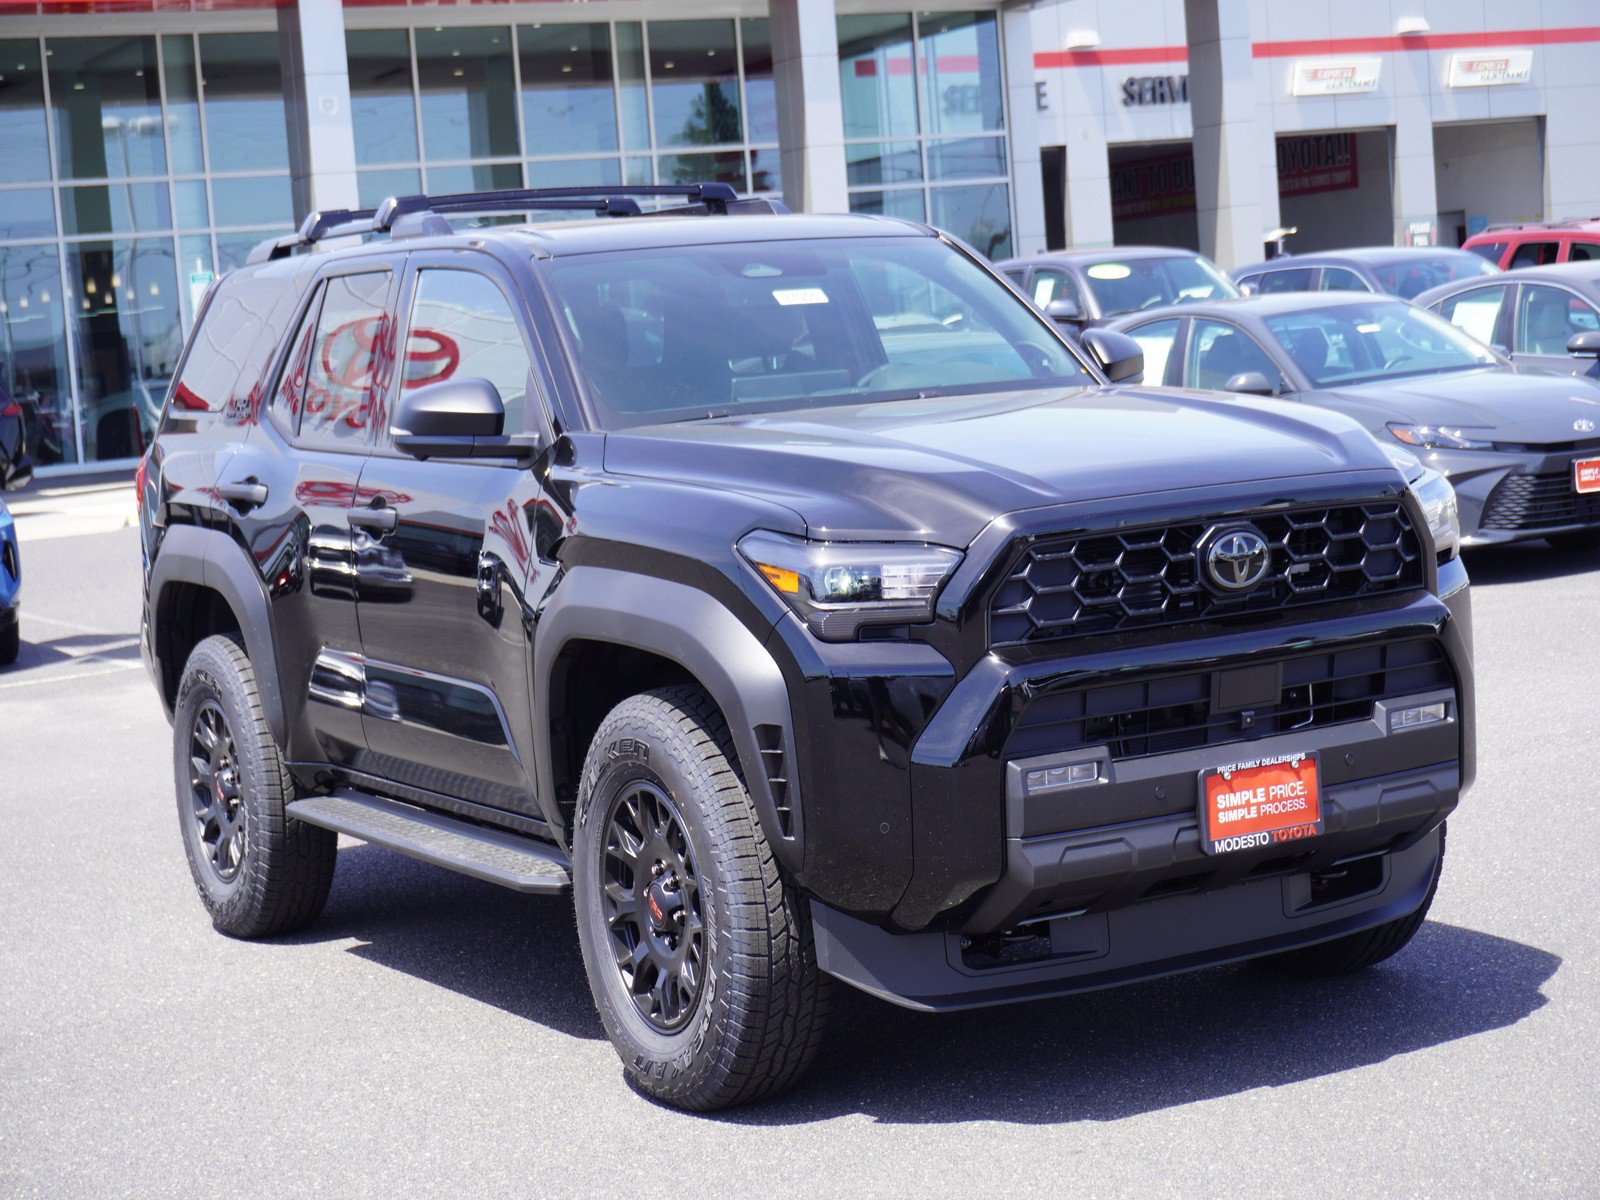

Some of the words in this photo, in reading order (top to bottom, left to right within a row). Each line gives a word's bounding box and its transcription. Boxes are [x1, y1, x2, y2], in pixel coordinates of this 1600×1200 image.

[1217, 764, 1236, 774] PRICE
[1237, 760, 1260, 772] FAMILY
[1262, 752, 1305, 766] DEALERSHIPS
[1217, 788, 1266, 809] SIMPLE
[1269, 781, 1307, 800] PRICE.
[1218, 806, 1258, 823] SIMPLE
[1260, 798, 1307, 816] PROCESS.
[1214, 832, 1269, 853] MODESTO
[1272, 824, 1316, 842] TOYOTA
